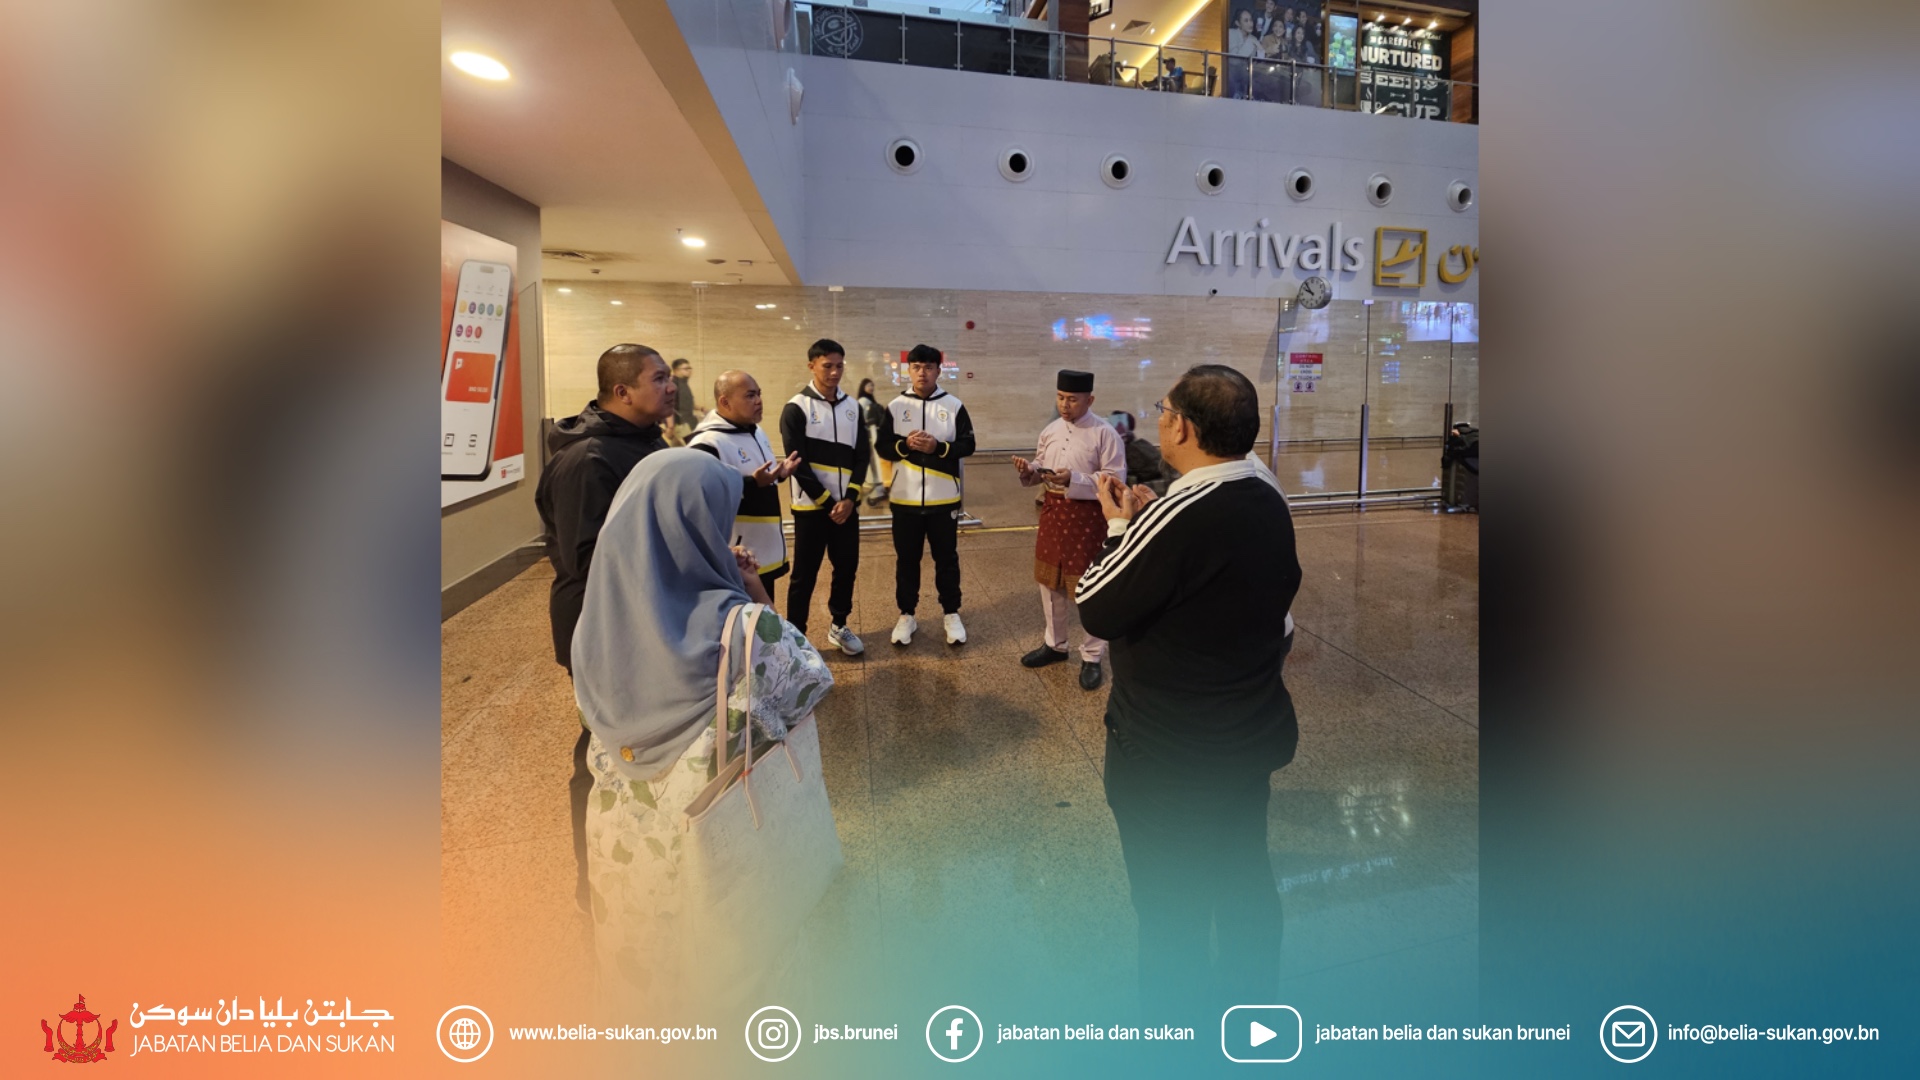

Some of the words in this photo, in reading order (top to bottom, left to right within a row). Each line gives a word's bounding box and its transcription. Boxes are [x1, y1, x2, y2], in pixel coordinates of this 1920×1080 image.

[1377, 35, 1422, 50] CAREFULLY
[1361, 46, 1443, 72] NURTURED
[1166, 216, 1365, 273] Arrivals
